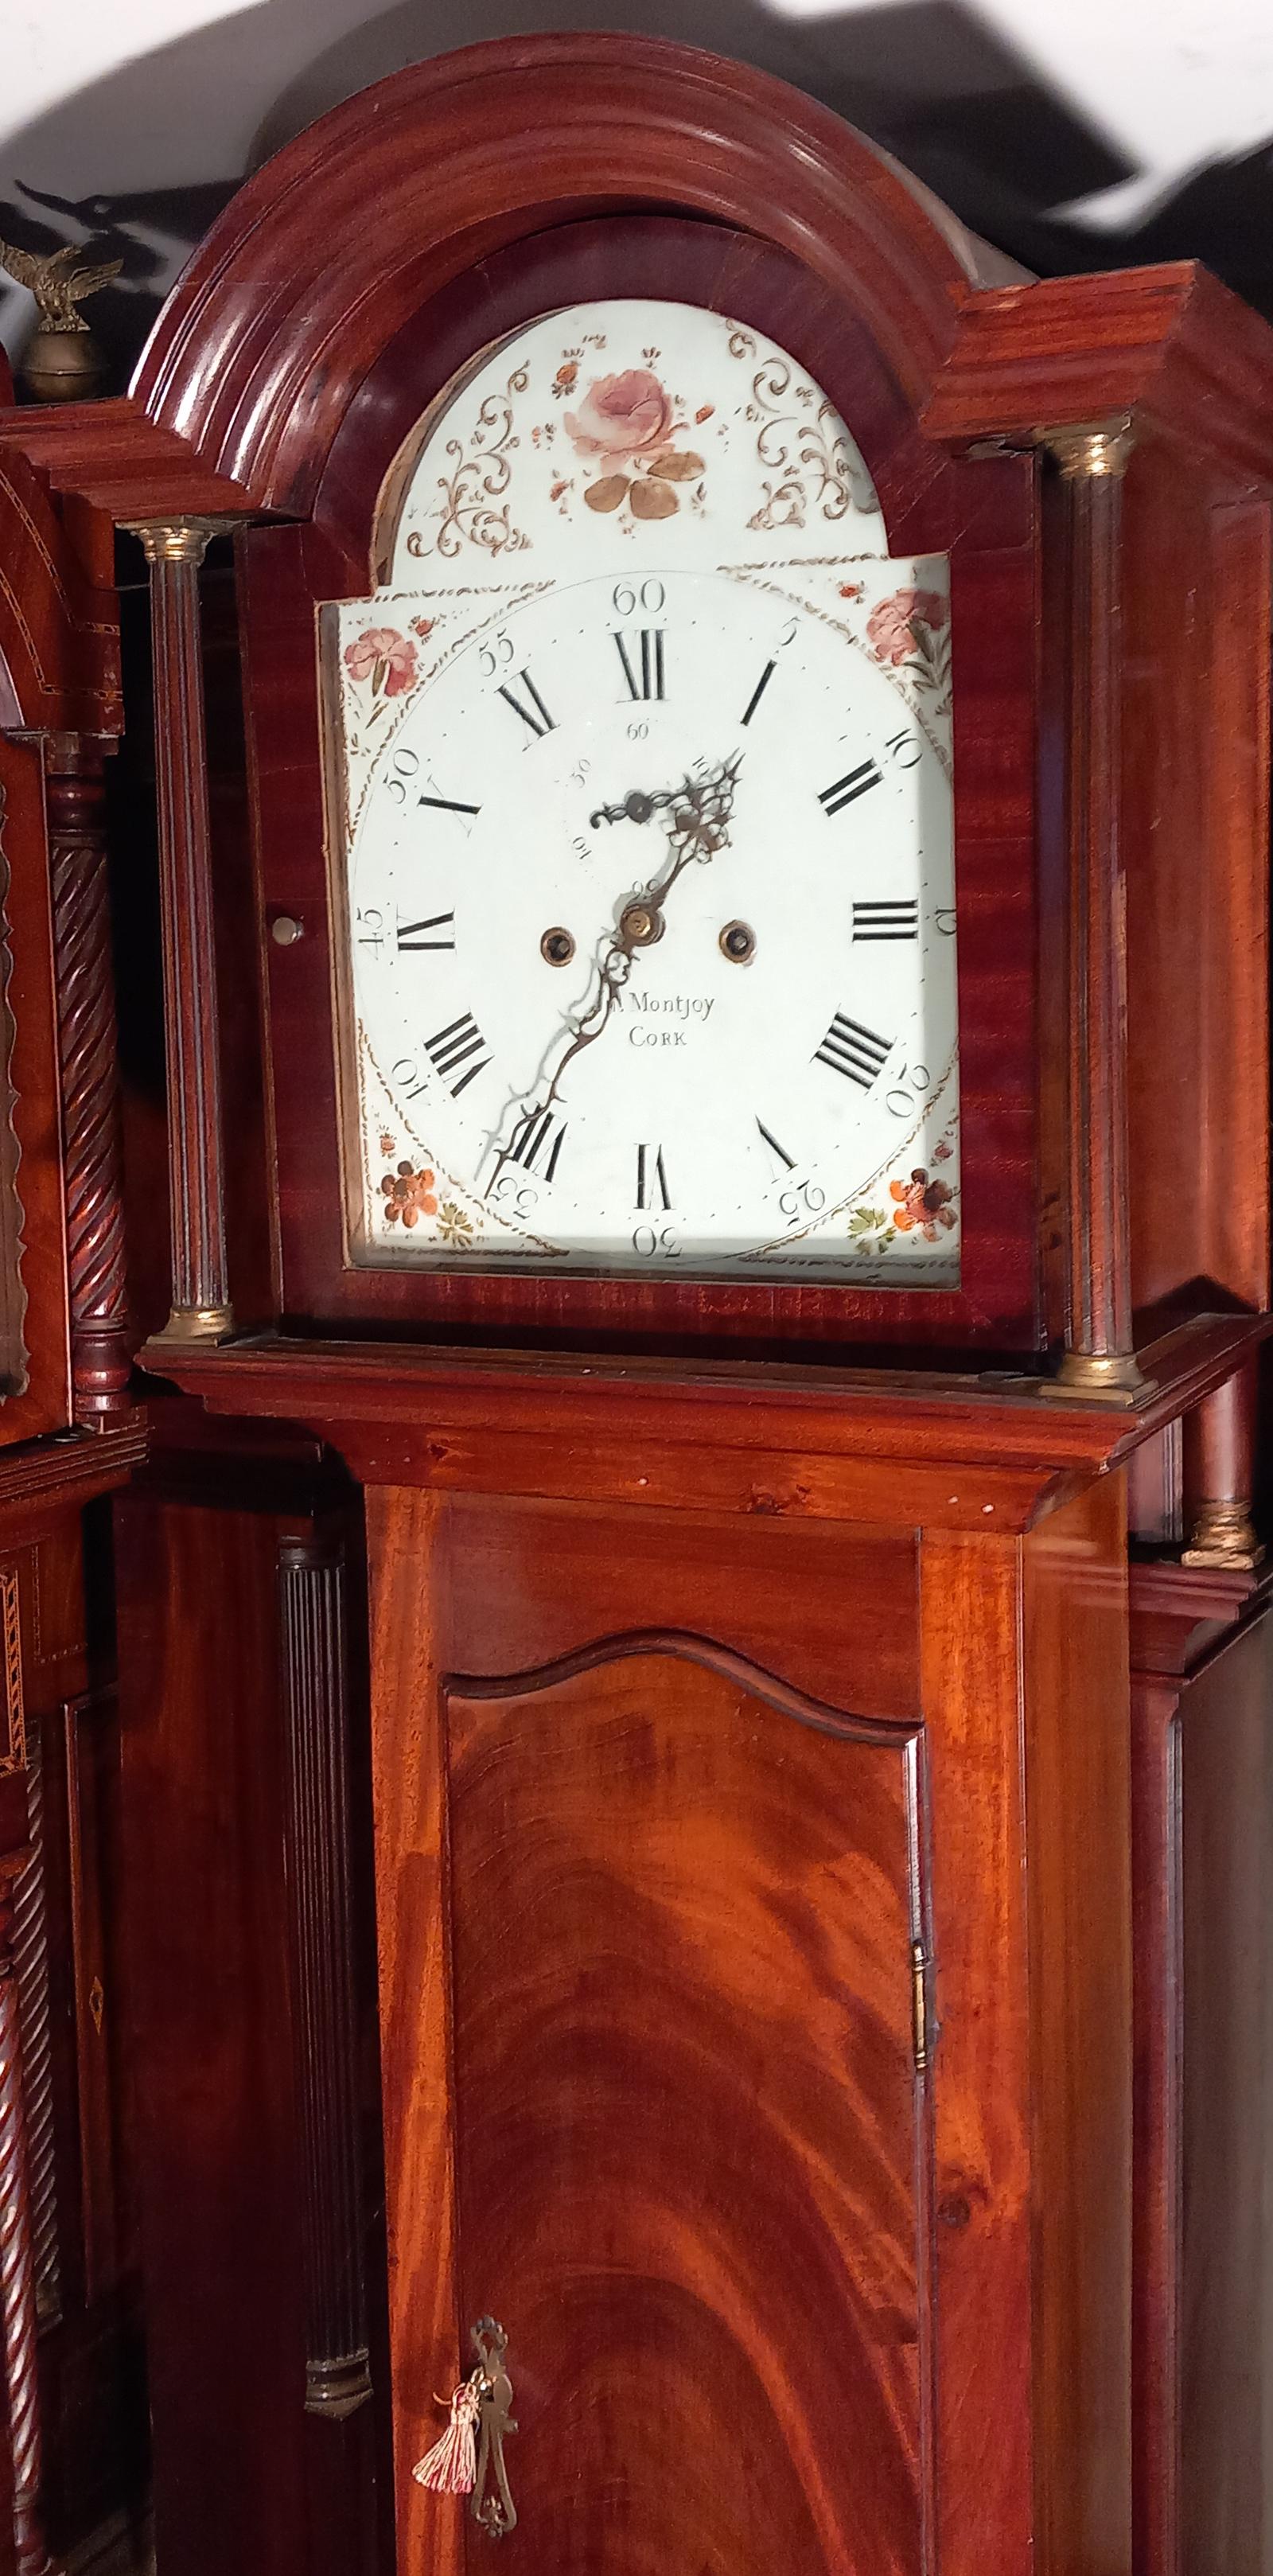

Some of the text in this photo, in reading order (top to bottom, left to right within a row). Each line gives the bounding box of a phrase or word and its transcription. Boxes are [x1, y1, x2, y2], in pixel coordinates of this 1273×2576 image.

[613, 579, 666, 616] 60
[479, 629, 514, 676] 55
[609, 629, 670, 703] XII
[494, 666, 561, 751] XI
[627, 723, 648, 740] 60
[885, 728, 923, 769] 10
[383, 749, 419, 804] 50
[818, 758, 885, 817] II
[852, 898, 919, 943] III
[629, 991, 715, 1021] Montjoy
[810, 1009, 897, 1096] IIII
[885, 1063, 931, 1118] 20
[489, 1177, 539, 1219] 35
[633, 1144, 675, 1210] VI
[779, 1179, 826, 1226] 25
[633, 1226, 683, 1258] 30
